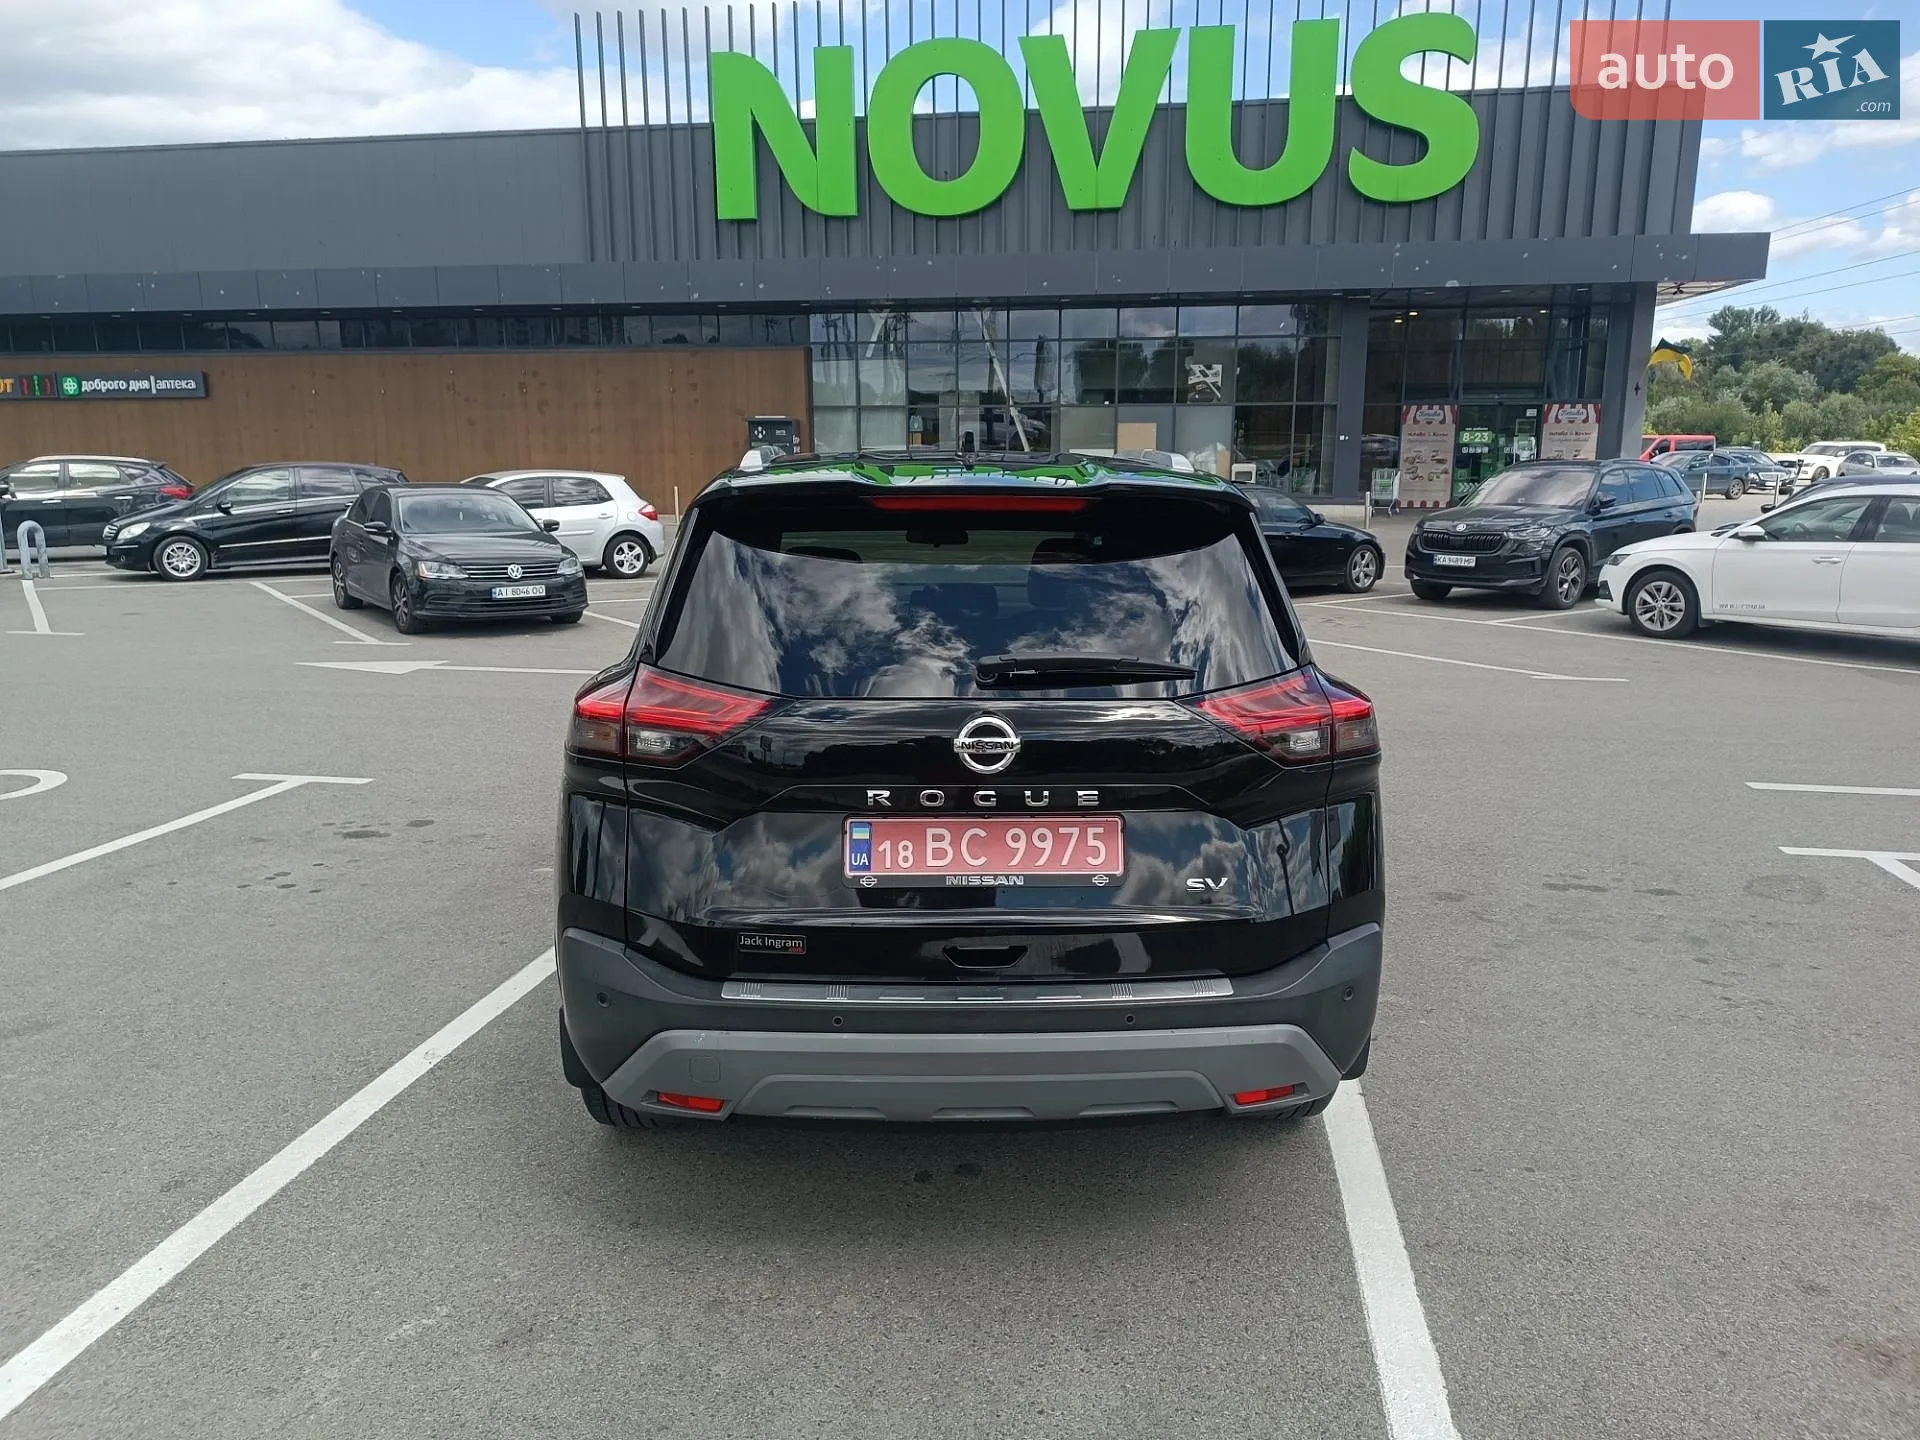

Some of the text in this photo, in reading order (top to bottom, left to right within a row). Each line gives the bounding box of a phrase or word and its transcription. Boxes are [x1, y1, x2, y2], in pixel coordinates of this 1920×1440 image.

[711, 12, 1480, 221] NOVUS
[81, 376, 196, 392] доброго дня аптека
[1463, 432, 1489, 442] 8-23
[961, 740, 1014, 751] NISSAN
[866, 789, 1100, 807] ROGUE
[851, 827, 1106, 869] UA 18 BC 9975
[946, 875, 1024, 886] NISSAN
[1186, 877, 1228, 892] SV
[739, 935, 803, 949] Jack Ingram
